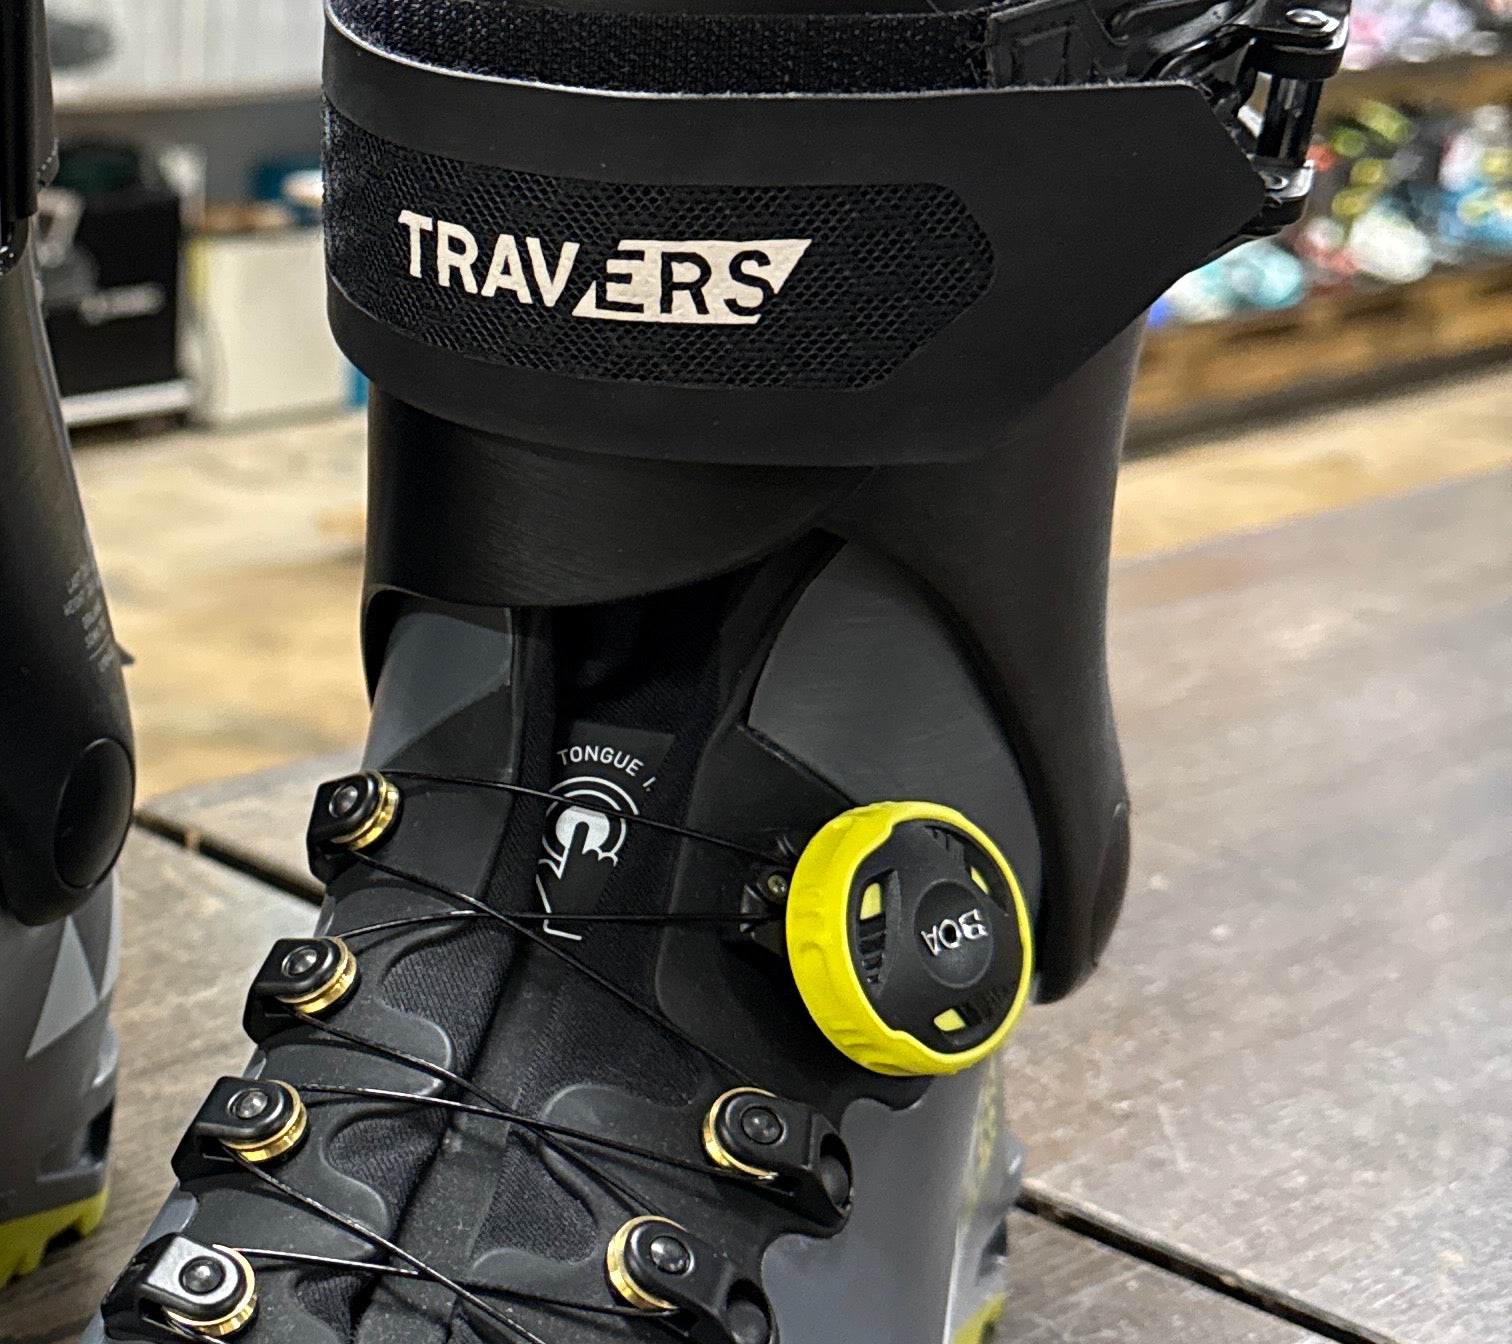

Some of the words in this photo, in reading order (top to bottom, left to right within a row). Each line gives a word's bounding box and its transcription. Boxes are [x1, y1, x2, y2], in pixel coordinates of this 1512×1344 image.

[397, 210, 813, 324] TRAVERS
[556, 745, 645, 777] TONGUE
[920, 908, 989, 957] BOA
